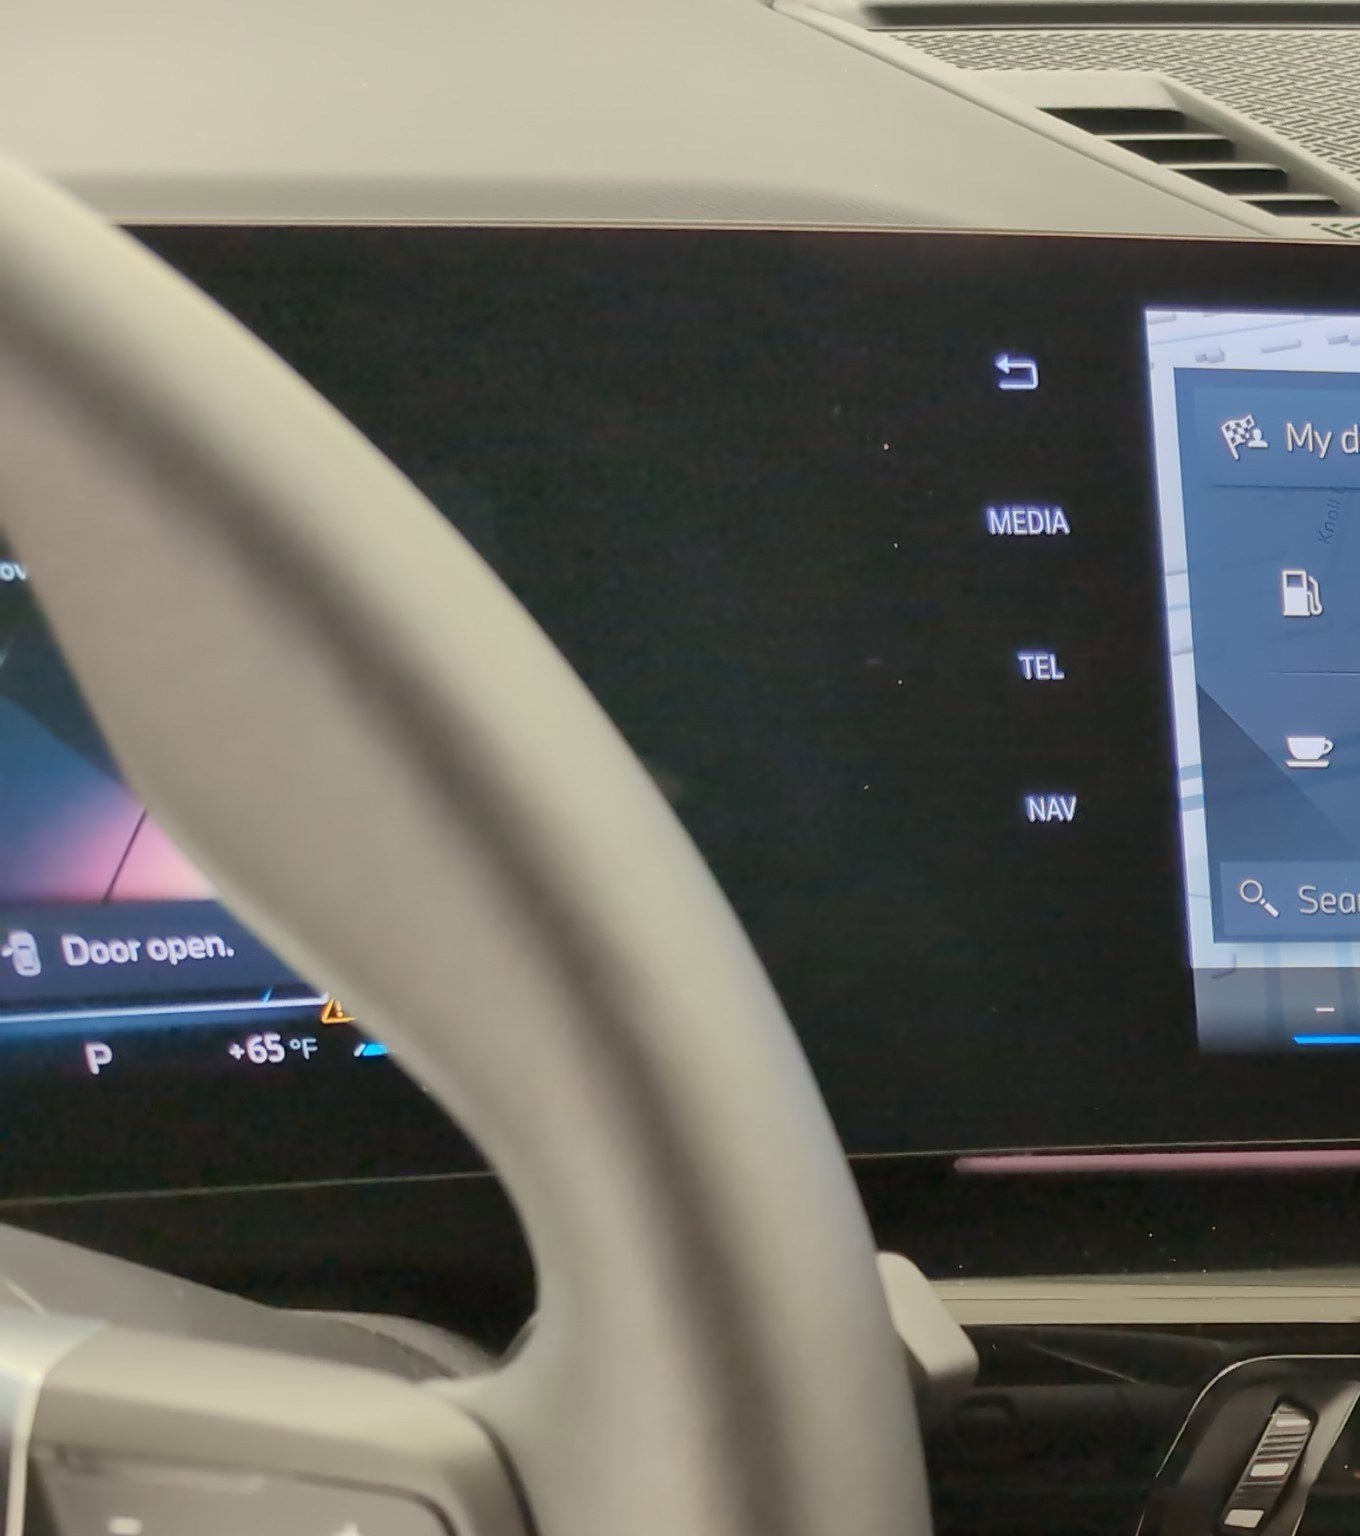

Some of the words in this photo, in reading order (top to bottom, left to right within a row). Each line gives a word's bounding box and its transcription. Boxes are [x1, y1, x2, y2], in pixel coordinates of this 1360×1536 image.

[1286, 422, 1332, 459] My
[987, 508, 1070, 535] MEDIA
[1018, 653, 1065, 680] TEL
[1025, 796, 1077, 822] NAV
[61, 933, 141, 966] Door
[146, 935, 235, 966] open.
[84, 1041, 113, 1075] P
